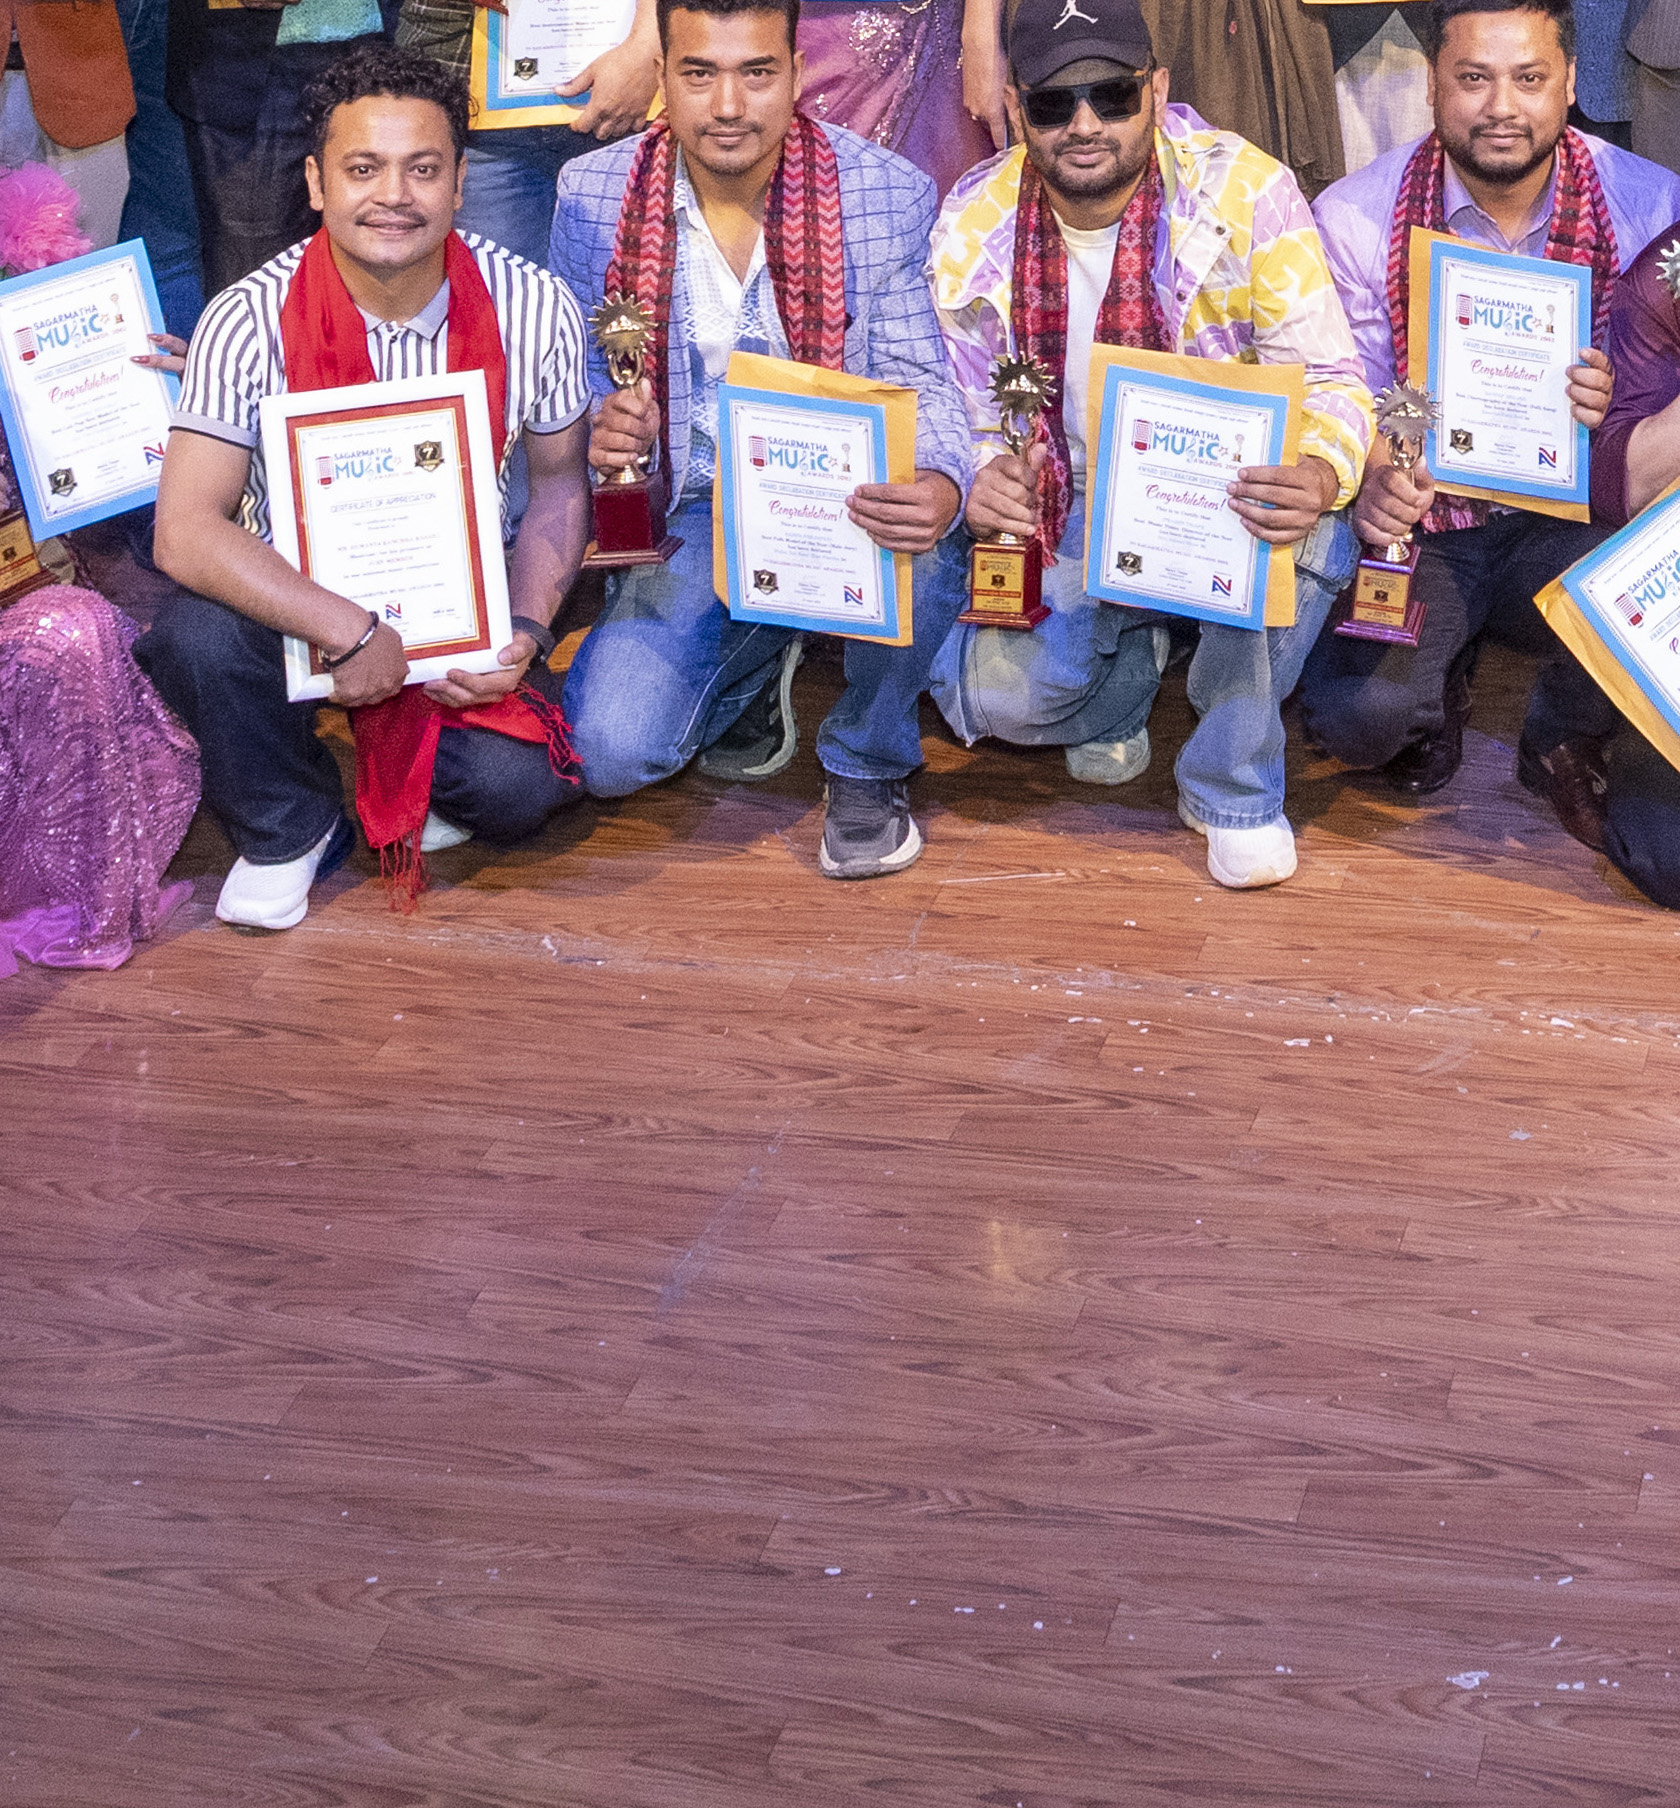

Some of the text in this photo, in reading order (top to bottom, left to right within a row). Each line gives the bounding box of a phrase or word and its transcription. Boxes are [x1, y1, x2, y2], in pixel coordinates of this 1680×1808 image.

[1474, 295, 1534, 313] SAGARMATHA
[33, 304, 98, 331] SAGARMATHA
[1154, 421, 1220, 442] SAGARMATHA
[768, 436, 828, 452] SAGARMATHA
[1627, 548, 1680, 596] SAGARMATHA
